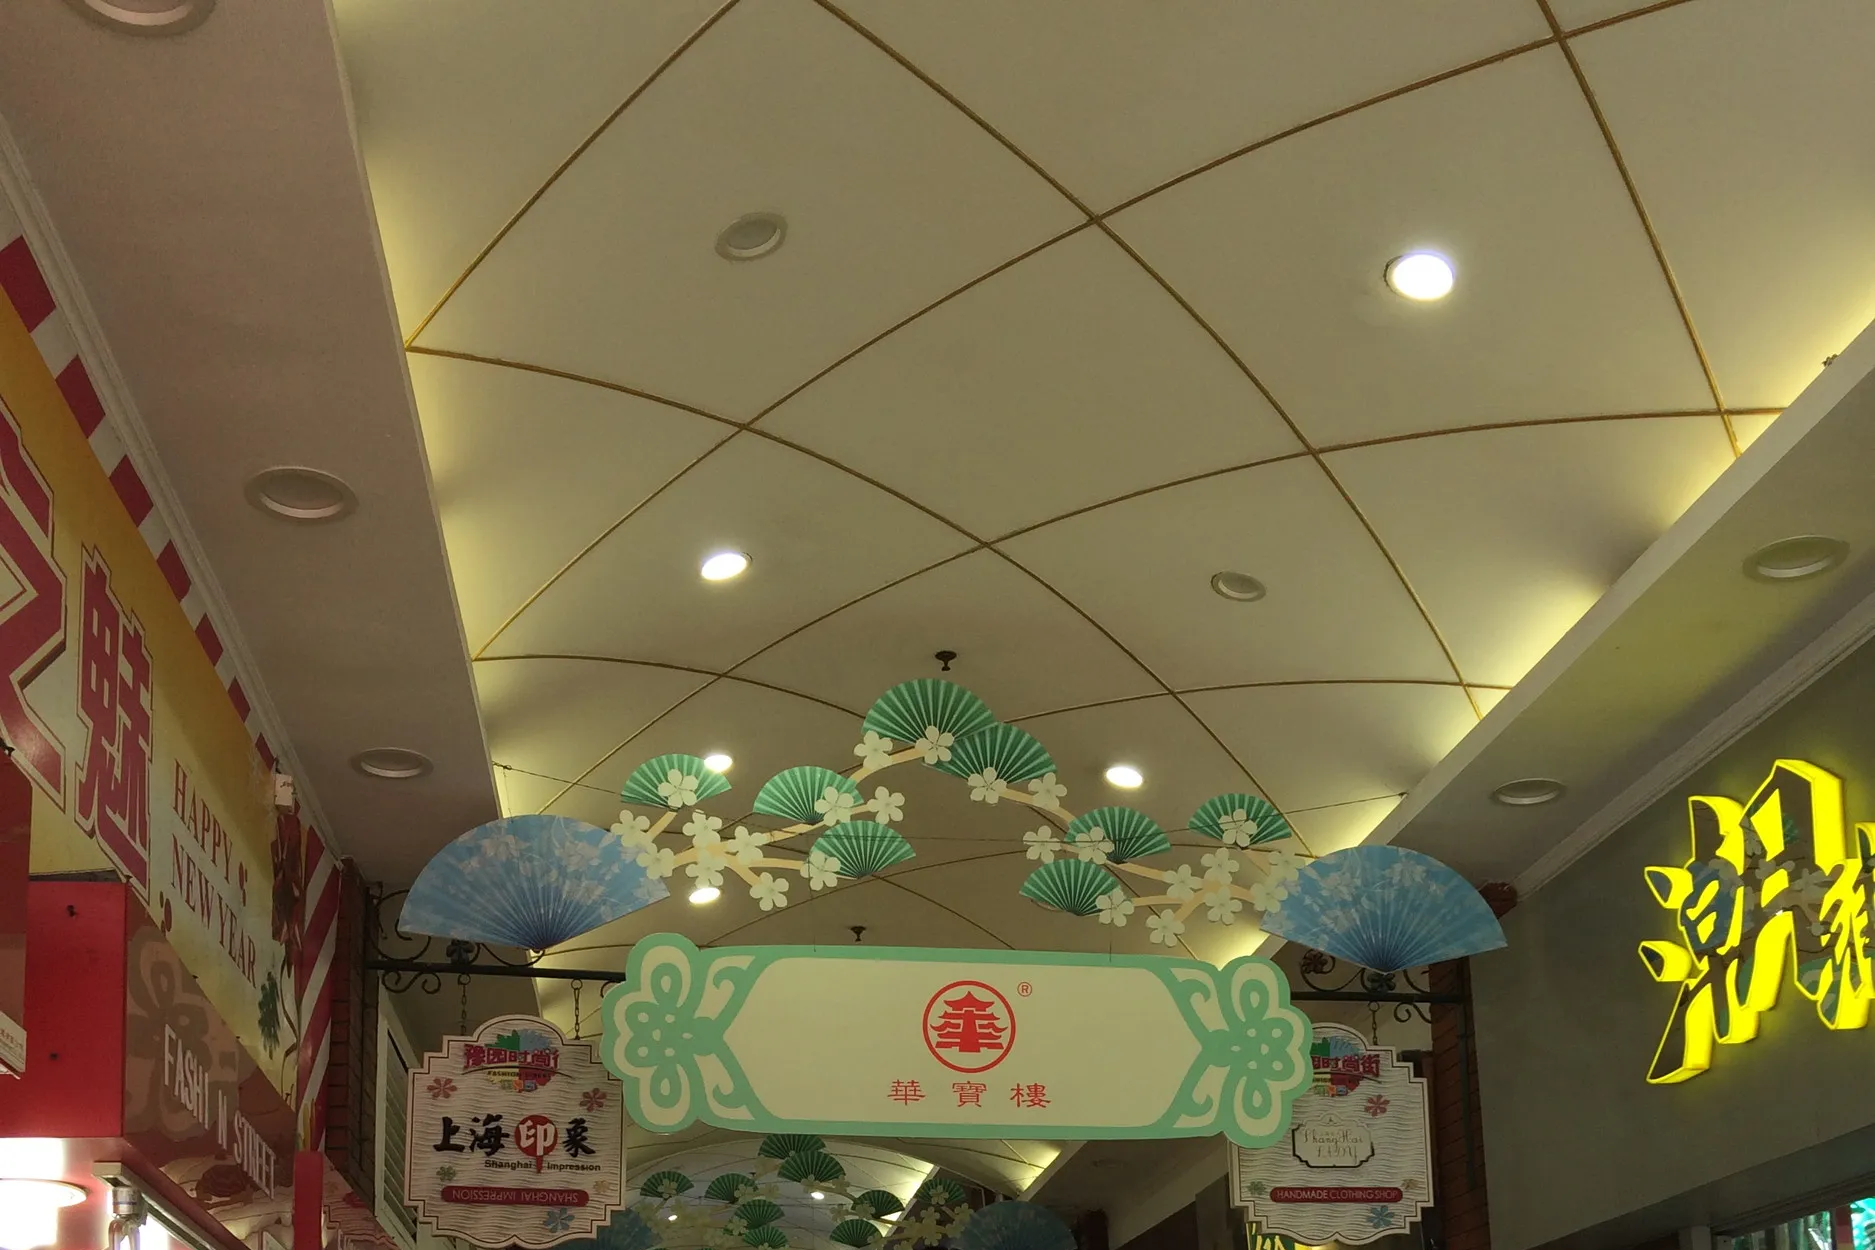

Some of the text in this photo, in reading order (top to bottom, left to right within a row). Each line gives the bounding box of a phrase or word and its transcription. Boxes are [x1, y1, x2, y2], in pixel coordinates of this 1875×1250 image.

[173, 757, 233, 885] HAPPY
[171, 833, 257, 990] NEW YEAR
[888, 1079, 1051, 1108] 華寶樓
[433, 1113, 596, 1158] 上海印象
[233, 1109, 277, 1201] STREET
[484, 1159, 533, 1171] Shanghai
[452, 1189, 579, 1204] SHANGHAI IMPRESSION
[1276, 1189, 1398, 1200] HANDMADE CLOTHING SHOP
